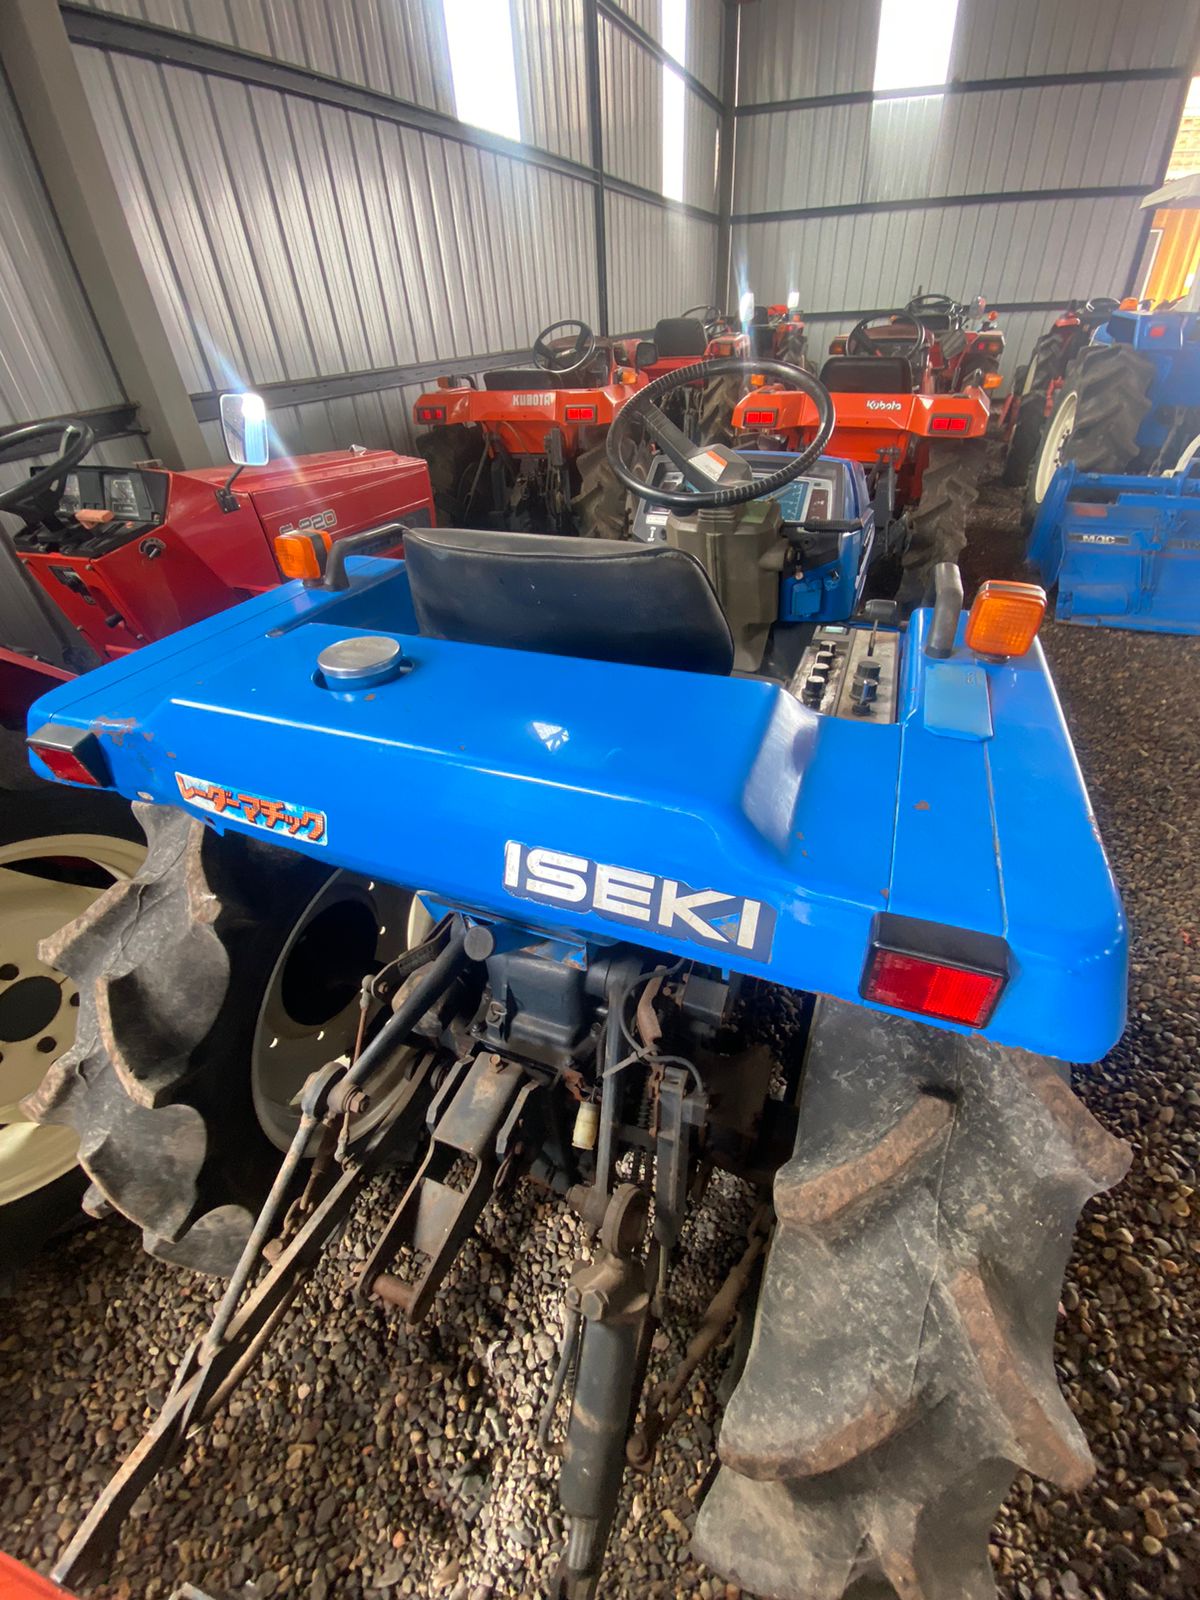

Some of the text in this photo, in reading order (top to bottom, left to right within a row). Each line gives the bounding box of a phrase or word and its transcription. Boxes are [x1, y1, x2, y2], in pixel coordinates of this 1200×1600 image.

[512, 393, 552, 407] KUBOTA
[866, 400, 902, 411] Kubota
[175, 774, 326, 841] レーダーマチック
[504, 842, 762, 951] ISEKI
